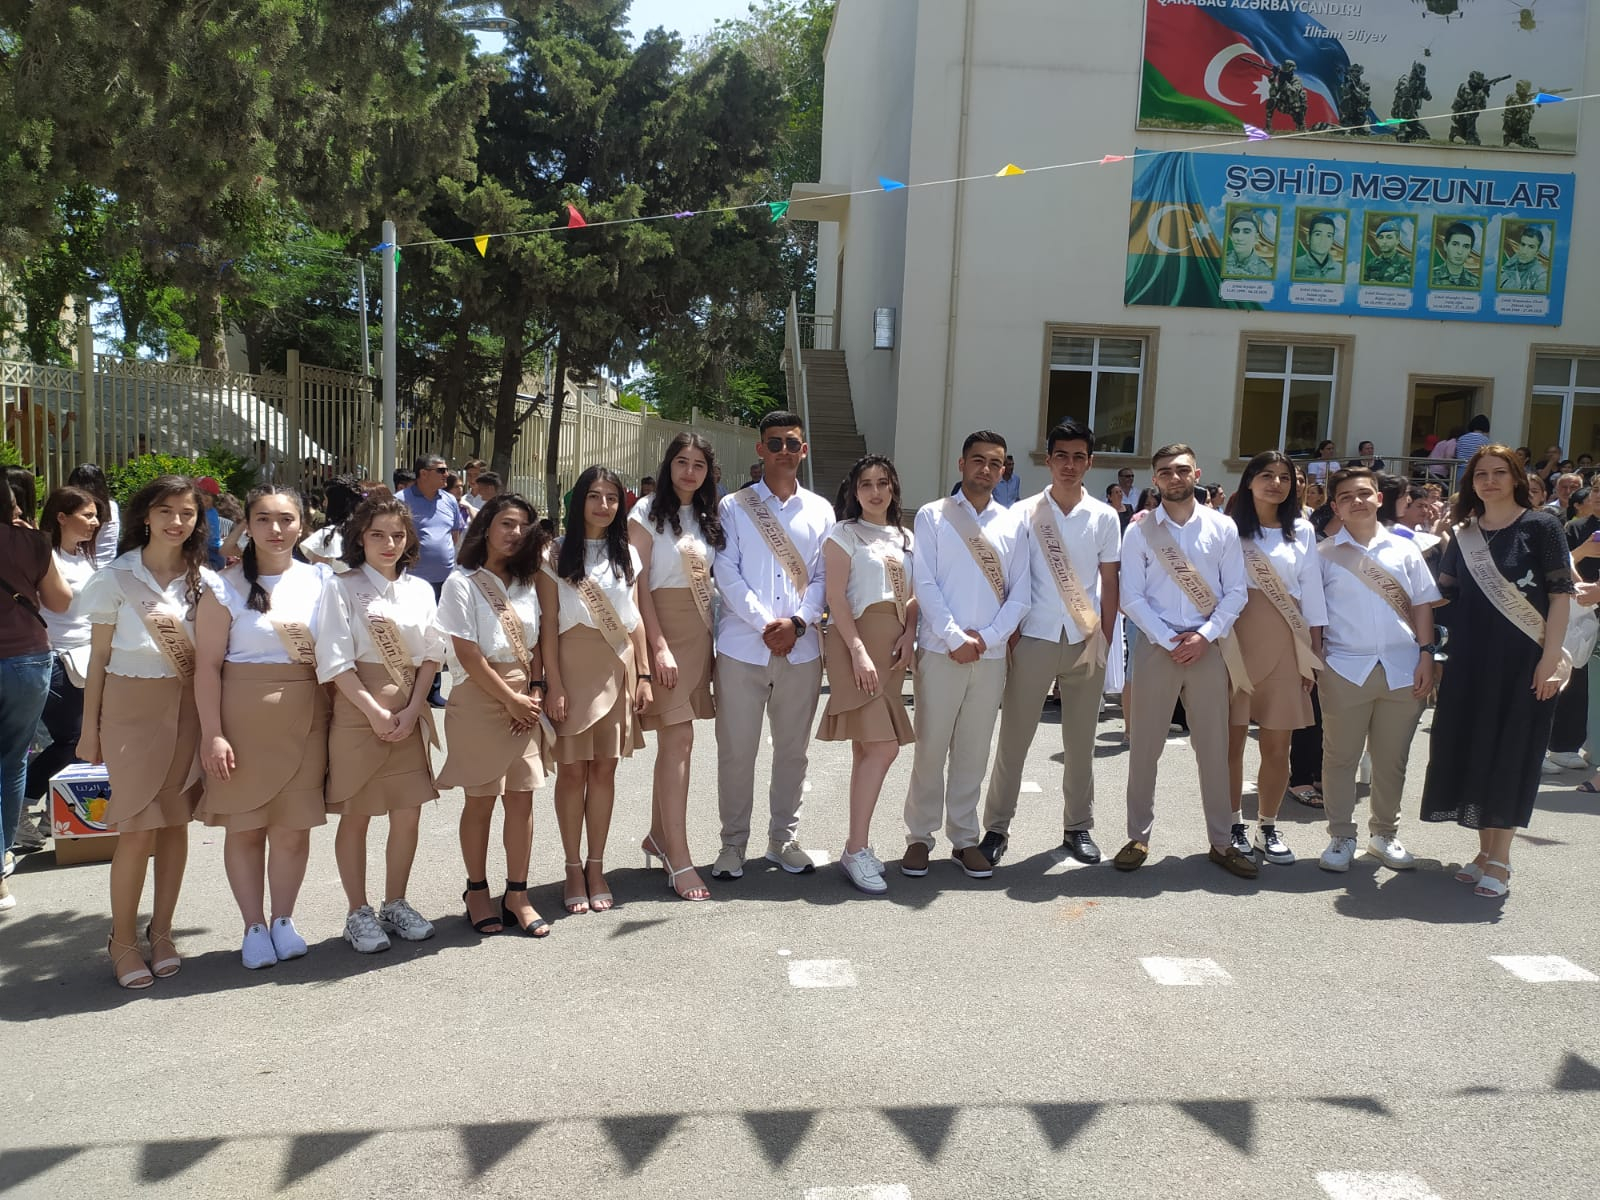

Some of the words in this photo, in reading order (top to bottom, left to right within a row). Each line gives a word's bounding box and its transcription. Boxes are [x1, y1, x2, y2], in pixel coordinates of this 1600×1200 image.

[1303, 23, 1343, 40] İlham
[1347, 32, 1388, 44] Əliyev
[1224, 163, 1344, 199] ŞƏHİD
[1351, 172, 1561, 210] MƏZUNLAR
[751, 503, 788, 548] Məzun
[689, 557, 714, 603] Məzun
[976, 547, 1011, 592] Məzun
[1040, 536, 1078, 583] Məzun
[1169, 556, 1210, 601] Məzun
[1251, 558, 1287, 602] Məzun
[153, 611, 196, 668] Məzun
[365, 608, 404, 657] Məzun
